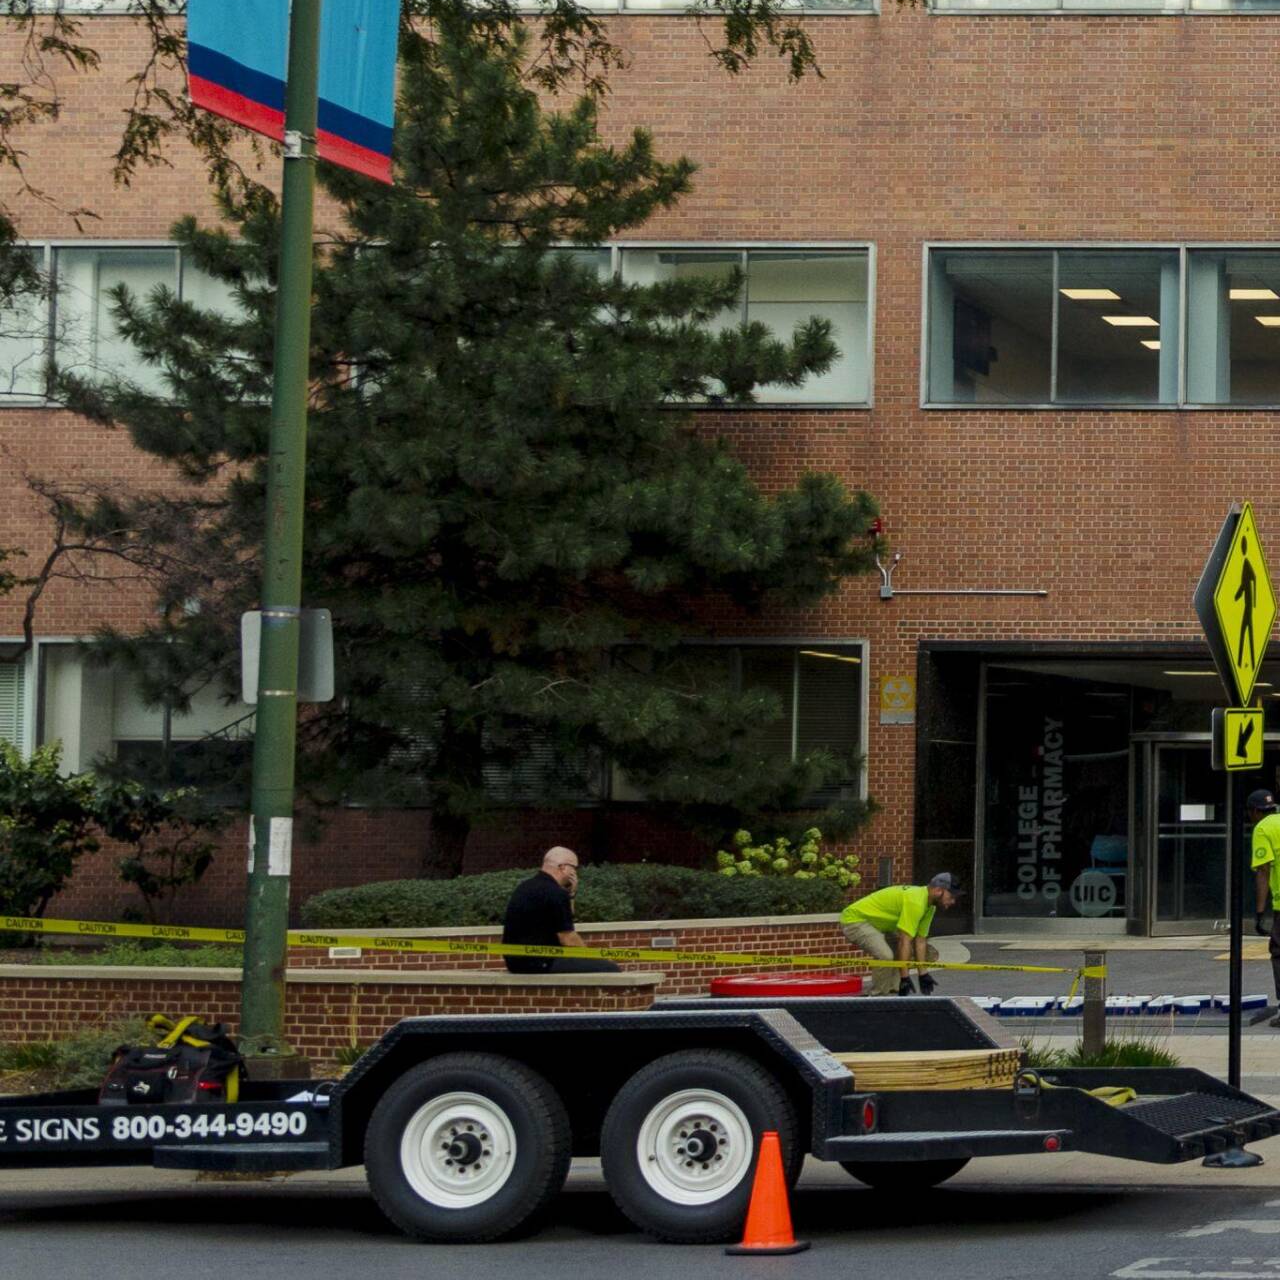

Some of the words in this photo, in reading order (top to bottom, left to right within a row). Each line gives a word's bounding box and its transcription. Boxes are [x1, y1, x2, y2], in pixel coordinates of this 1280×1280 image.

[1041, 716, 1064, 860] PHARMACY
[1018, 785, 1038, 900] COLLEGE
[1041, 866, 1062, 900] OF
[1074, 885, 1111, 902] UIC
[6, 918, 43, 929] CAUTION
[78, 923, 116, 933] CAUTION
[152, 927, 190, 937] CAUTION
[300, 935, 338, 945] CAUTION
[374, 938, 413, 949] CAUTION
[449, 942, 489, 952] CAUTION
[15, 1117, 100, 1141] SIGNS
[112, 1111, 307, 1140] 800-344-9490
